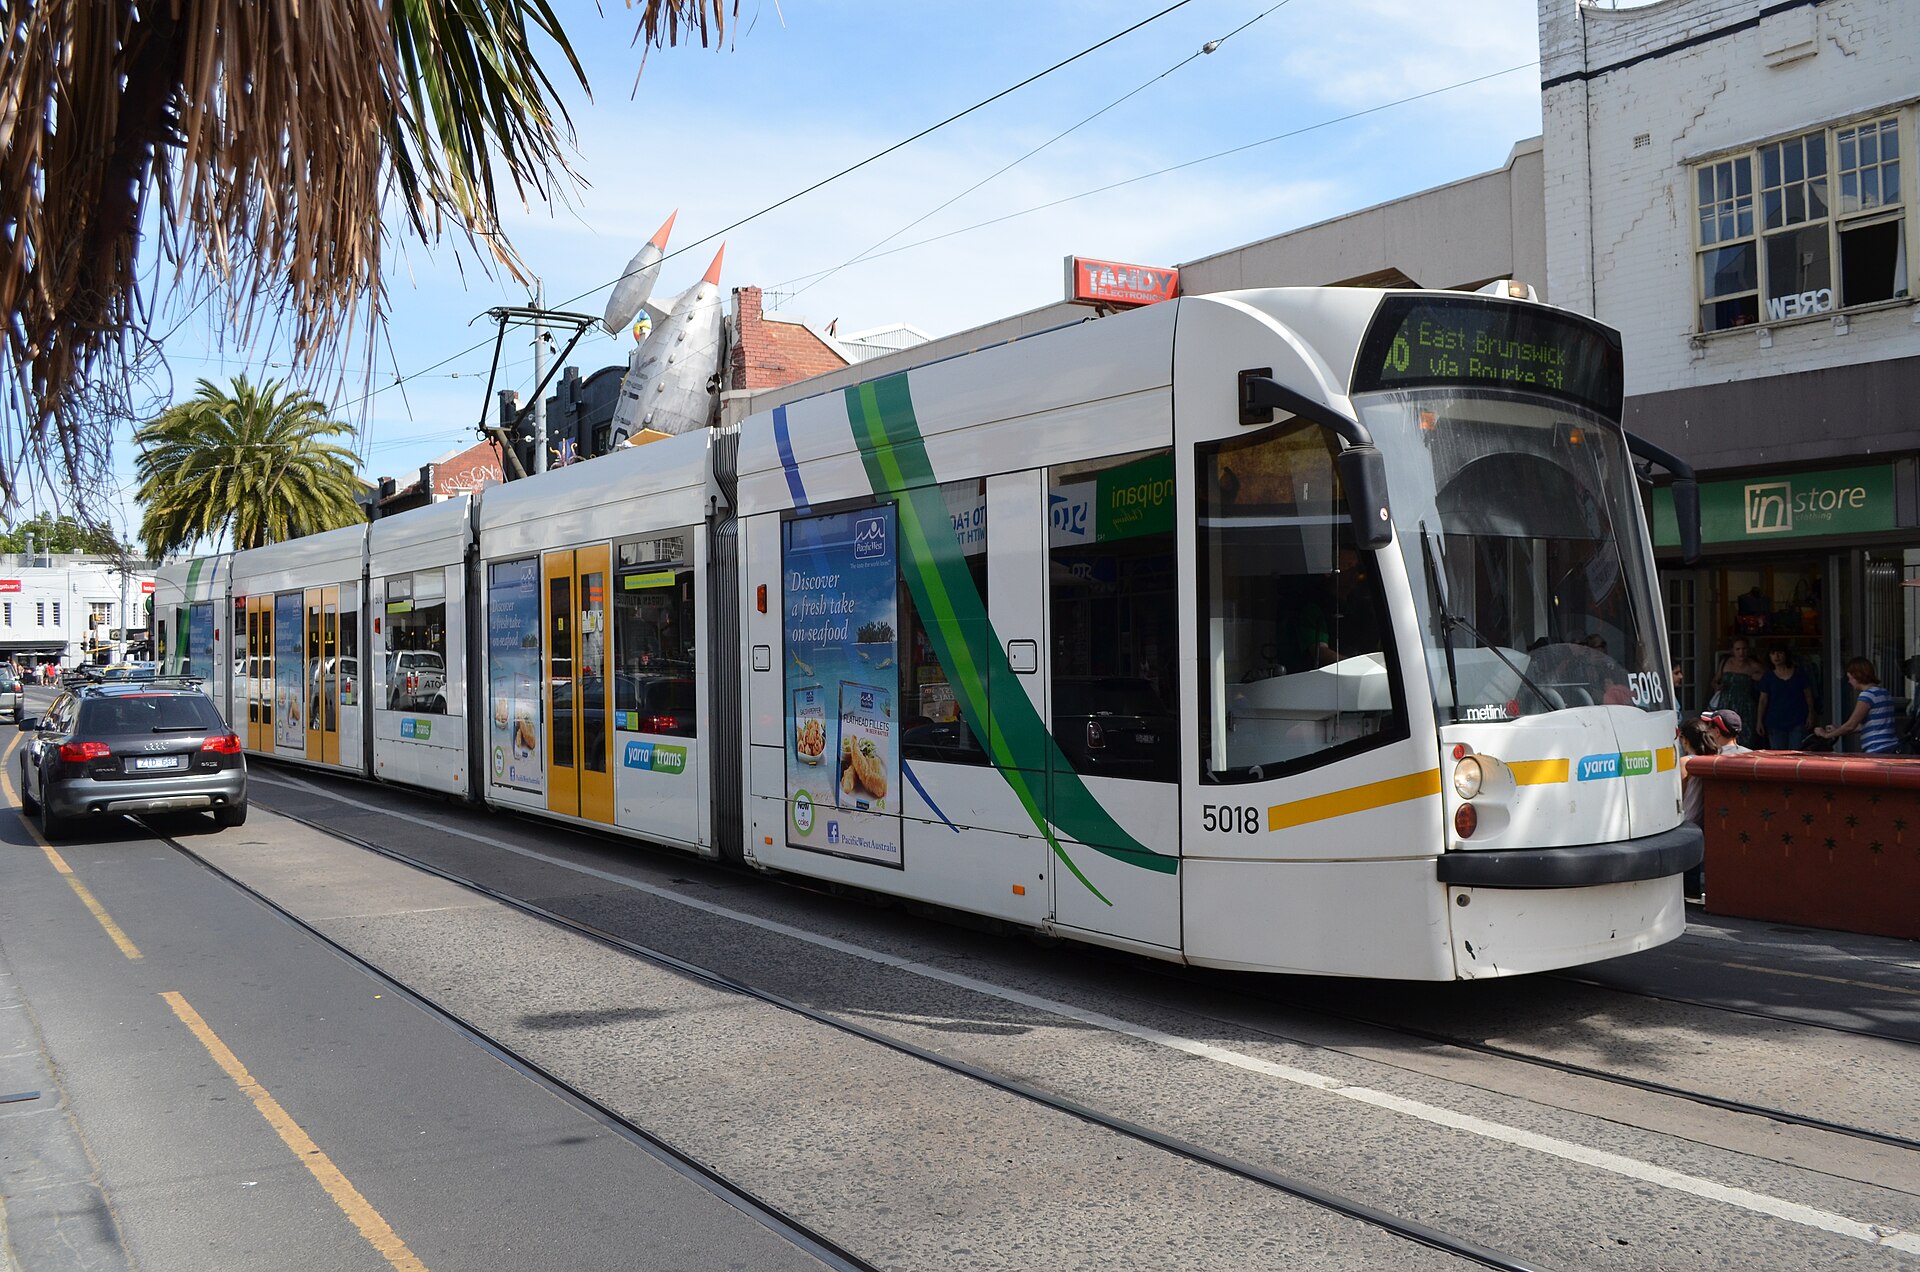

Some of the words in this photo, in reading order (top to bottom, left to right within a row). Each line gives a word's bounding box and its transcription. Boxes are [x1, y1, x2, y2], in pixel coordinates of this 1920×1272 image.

[1084, 263, 1173, 294] TANDY
[1099, 287, 1166, 301] ELECTRONICS
[1420, 321, 1465, 351] East
[1476, 329, 1566, 366] Brunswick
[1430, 354, 1459, 376] via
[1793, 486, 1866, 513] store
[1795, 511, 1832, 521] clothing
[792, 571, 840, 592] Discover
[492, 600, 514, 613] Discover
[791, 606, 798, 616] a
[800, 594, 826, 622] fresh
[830, 592, 855, 614] take
[792, 629, 805, 642] on
[807, 619, 849, 647] seafood
[1627, 671, 1664, 706] 5018
[843, 713, 868, 728] FLATHEAD
[869, 719, 890, 732] FILLETS
[1466, 704, 1507, 720] metlink
[628, 747, 649, 764] yarra
[656, 749, 682, 767] trams
[1583, 759, 1616, 778] yarra
[1624, 754, 1650, 770] trams
[1203, 805, 1260, 834] 5018
[841, 834, 897, 853] PacificWestAustralia
